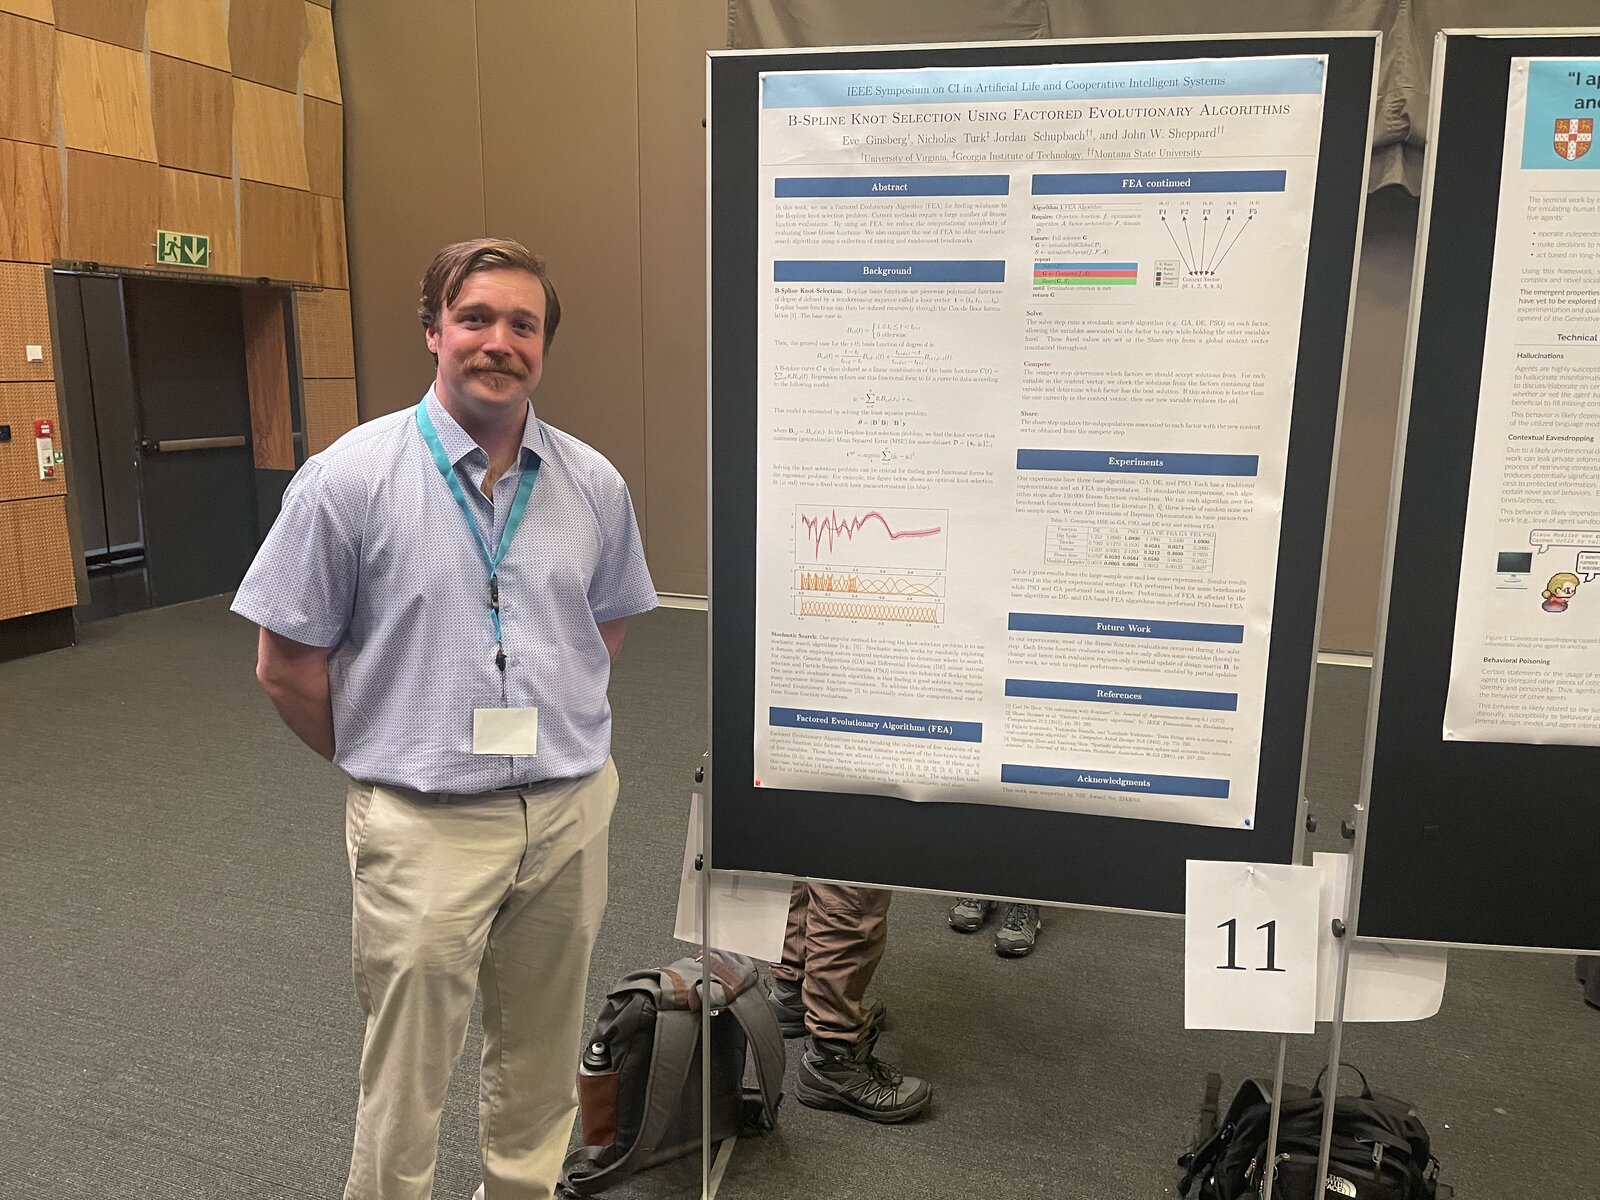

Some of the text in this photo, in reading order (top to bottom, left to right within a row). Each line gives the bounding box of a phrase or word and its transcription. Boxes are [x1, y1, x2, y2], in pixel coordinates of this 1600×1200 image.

[847, 86, 872, 96] IEEE
[875, 84, 929, 98] Symposium
[947, 83, 959, 93] CI
[963, 84, 972, 93] in
[976, 82, 1017, 92] Artificial
[1022, 81, 1040, 91] Life
[1043, 80, 1061, 90] and
[1065, 79, 1125, 92] Cooperative
[1129, 77, 1178, 91] Intelligent
[1182, 76, 1225, 89] Systems
[788, 104, 1290, 126] B-SPLINE KNOT SELECTION USING FACTORED EVOLUTIONARY ALGORITHMS
[842, 135, 859, 145] Eve
[917, 133, 956, 143] Nicholas
[993, 132, 1026, 142] Jordan
[1099, 130, 1117, 140] and
[1121, 129, 1145, 139] John
[1150, 129, 1164, 139] W.
[905, 152, 912, 161] of
[989, 151, 1023, 159] Institute
[1025, 151, 1033, 159] of
[1133, 149, 1156, 157] State
[1159, 148, 1201, 159] University
[872, 183, 907, 191] Abstract
[1122, 178, 1191, 188] FEA continued
[1586, 196, 1595, 204] by
[1538, 205, 1570, 213] emulating
[863, 266, 912, 276] Background
[1522, 268, 1540, 276] Using
[1520, 276, 1547, 284] complex
[1535, 298, 1546, 306] yet
[1567, 298, 1596, 306] explored
[1515, 365, 1538, 373] Agents
[1550, 366, 1570, 374] highly
[1545, 434, 1594, 443] Eavesdropping
[1108, 457, 1163, 469] Experiments
[1097, 623, 1151, 633] Future Work
[1483, 656, 1550, 667] Behavioral Poisoning
[1097, 690, 1142, 699] References
[796, 714, 952, 735] Factored Evolutionary Algorithms (FEA)
[1077, 774, 1151, 788] Acknowledgments
[1216, 918, 1286, 972] 11
